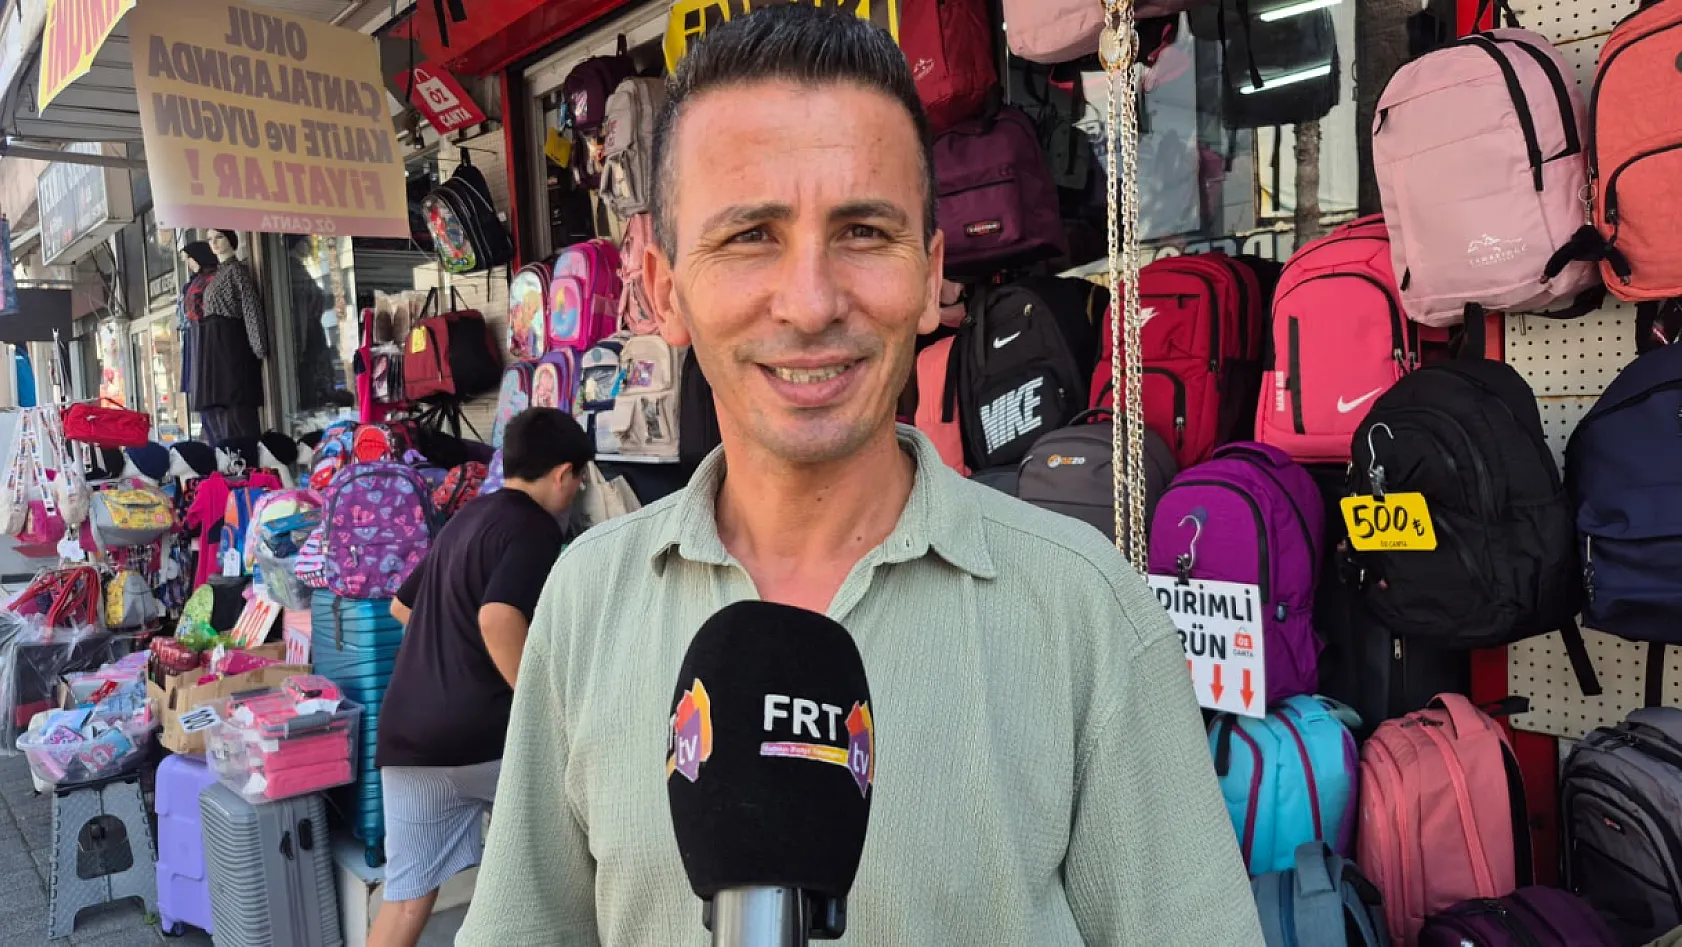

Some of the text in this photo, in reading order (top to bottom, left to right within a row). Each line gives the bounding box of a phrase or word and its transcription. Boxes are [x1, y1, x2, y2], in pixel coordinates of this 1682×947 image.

[980, 376, 1043, 454] NIKE
[1352, 505, 1407, 539] 500
[679, 735, 699, 766] tv
[764, 694, 843, 741] FRT
[853, 741, 870, 776] tv
